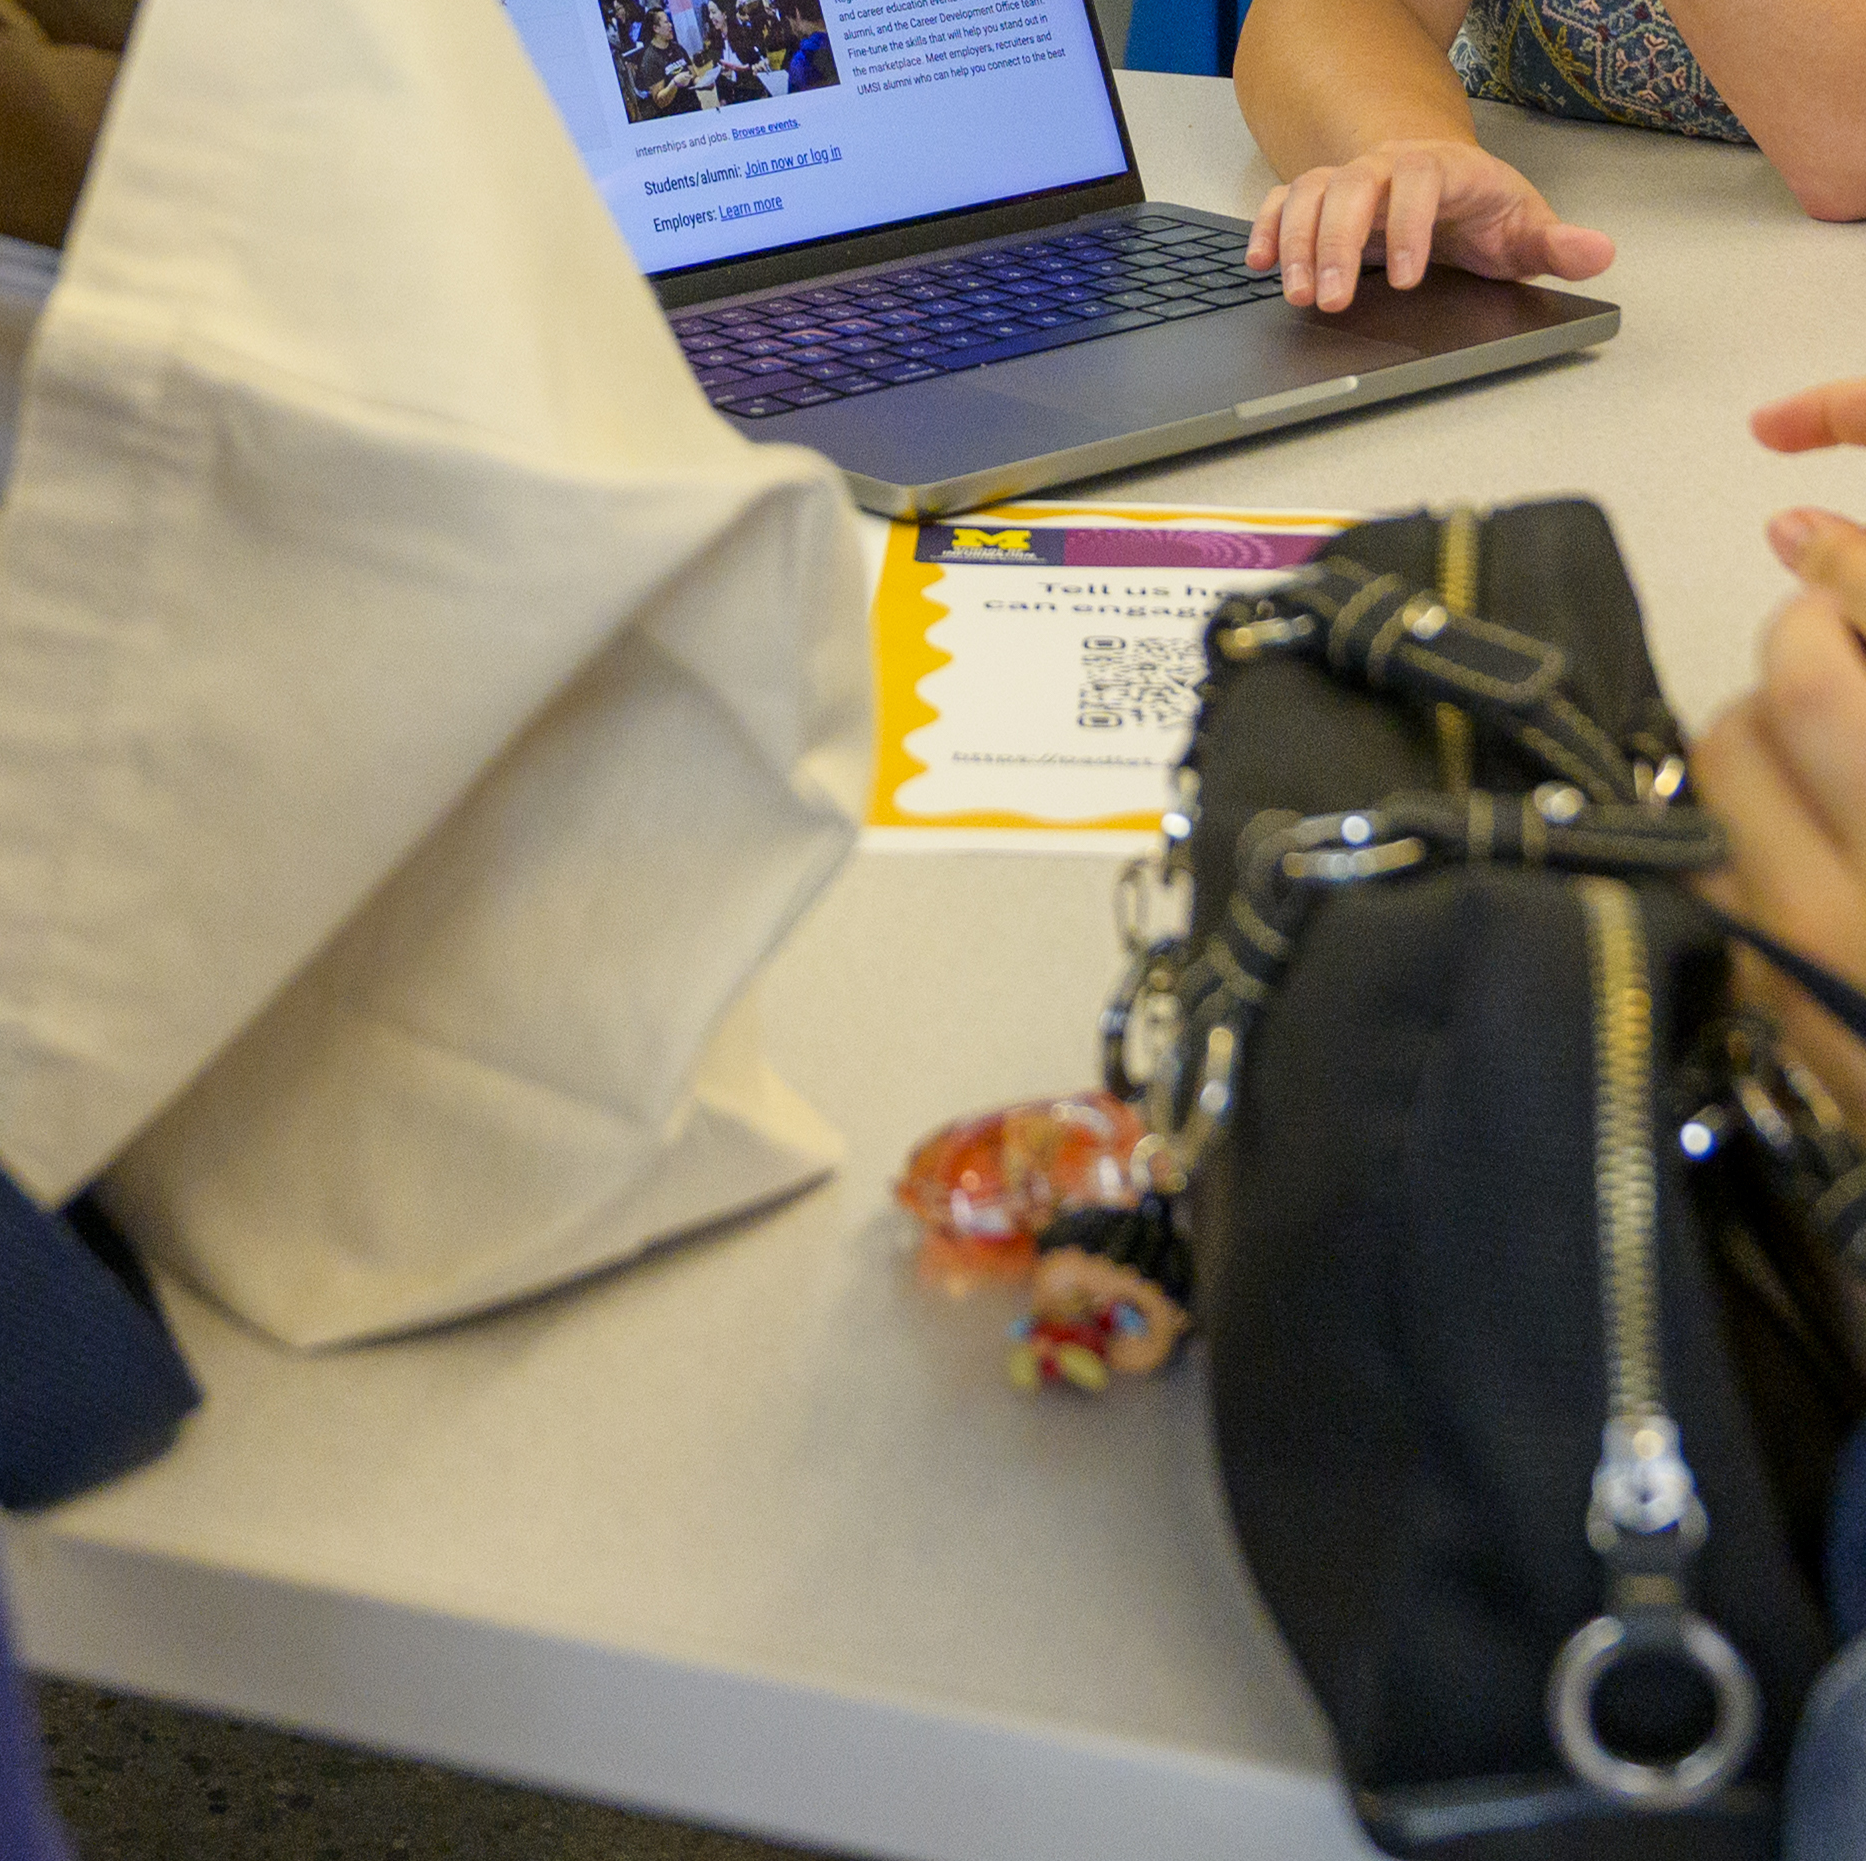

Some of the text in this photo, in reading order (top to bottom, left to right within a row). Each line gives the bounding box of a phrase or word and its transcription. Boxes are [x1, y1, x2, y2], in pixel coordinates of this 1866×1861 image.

[838, 9, 855, 21] and
[856, 6, 883, 18] career
[885, 0, 928, 13] education
[843, 28, 875, 40] alumni,
[876, 21, 893, 34] and
[893, 20, 908, 30] the
[909, 16, 937, 27] Career
[939, 5, 993, 22] Development
[995, 0, 1019, 12] Office
[847, 13, 1048, 58] Fine-tune the skills that will help you stand out in
[852, 30, 1052, 76] the marketplace. Meet employers, recruiters and
[857, 47, 1065, 95] UMSI alumni who can help you connect to the best
[634, 116, 801, 159] internships and jobs. Browse events.
[642, 143, 842, 197] Students/alumni: Join now or log in
[652, 196, 784, 235] Employers: Learn more
[984, 599, 1058, 612] can
[1038, 581, 1110, 595] Tell
[1125, 586, 1171, 596] us
